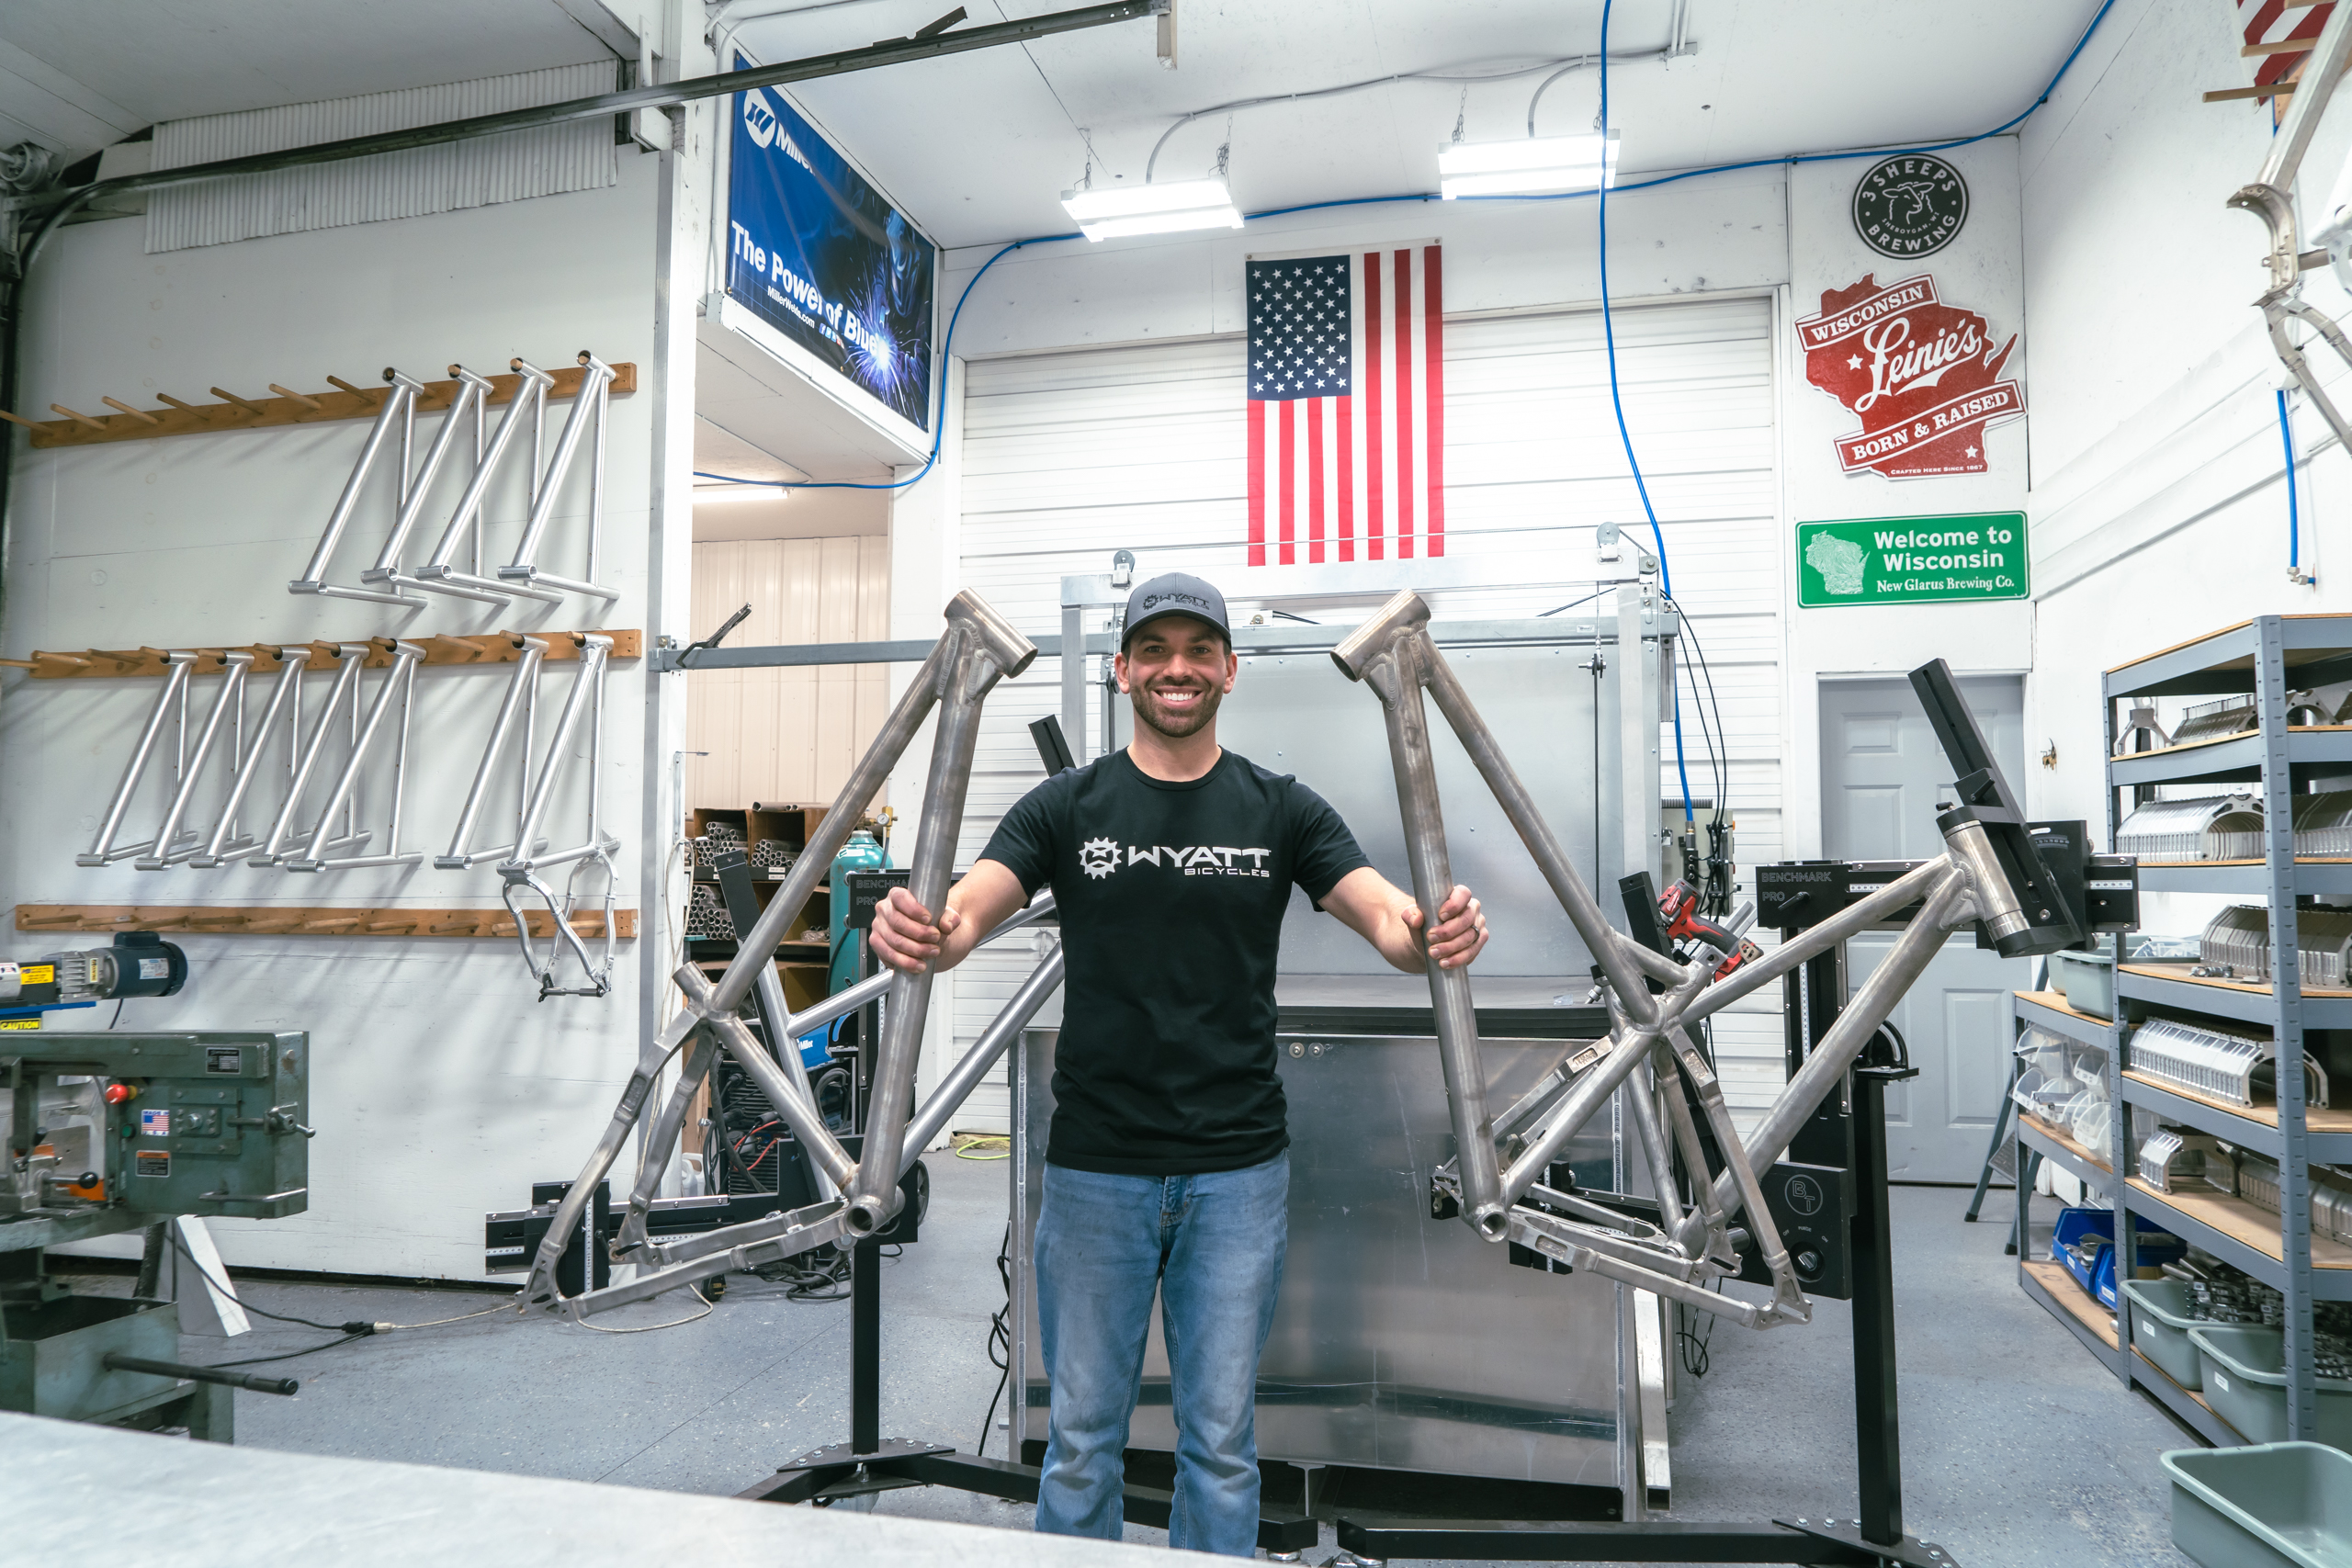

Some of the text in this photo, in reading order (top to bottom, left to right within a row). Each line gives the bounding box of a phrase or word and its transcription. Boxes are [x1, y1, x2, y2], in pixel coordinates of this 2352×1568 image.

[1862, 160, 1956, 202] 3 SHEEPS
[1930, 211, 1939, 221] WI
[1868, 214, 1956, 252] BREWING
[731, 220, 879, 355] The Power of Blue
[767, 285, 816, 328] MillerWelds.com
[1810, 284, 1924, 343] WISCONSIN
[1854, 316, 1983, 412] Leinie's
[1852, 391, 2009, 461] BORN & RAISED
[1874, 525, 2012, 549] Welcome to
[1883, 549, 2004, 571] Wisconsin
[1876, 575, 2015, 592] New Glarus Brewing Co.
[1159, 592, 1210, 605] WYATT
[1174, 598, 1210, 610] BICYCLES
[1127, 845, 1270, 868] WYATT
[1184, 867, 1270, 878] BICYCLES
[1761, 871, 1832, 883] BENCHMARK
[855, 879, 910, 889] BENCHMA
[855, 897, 878, 906] PRO
[1762, 891, 1785, 902] PRO
[0, 1021, 39, 1030] CAUTION
